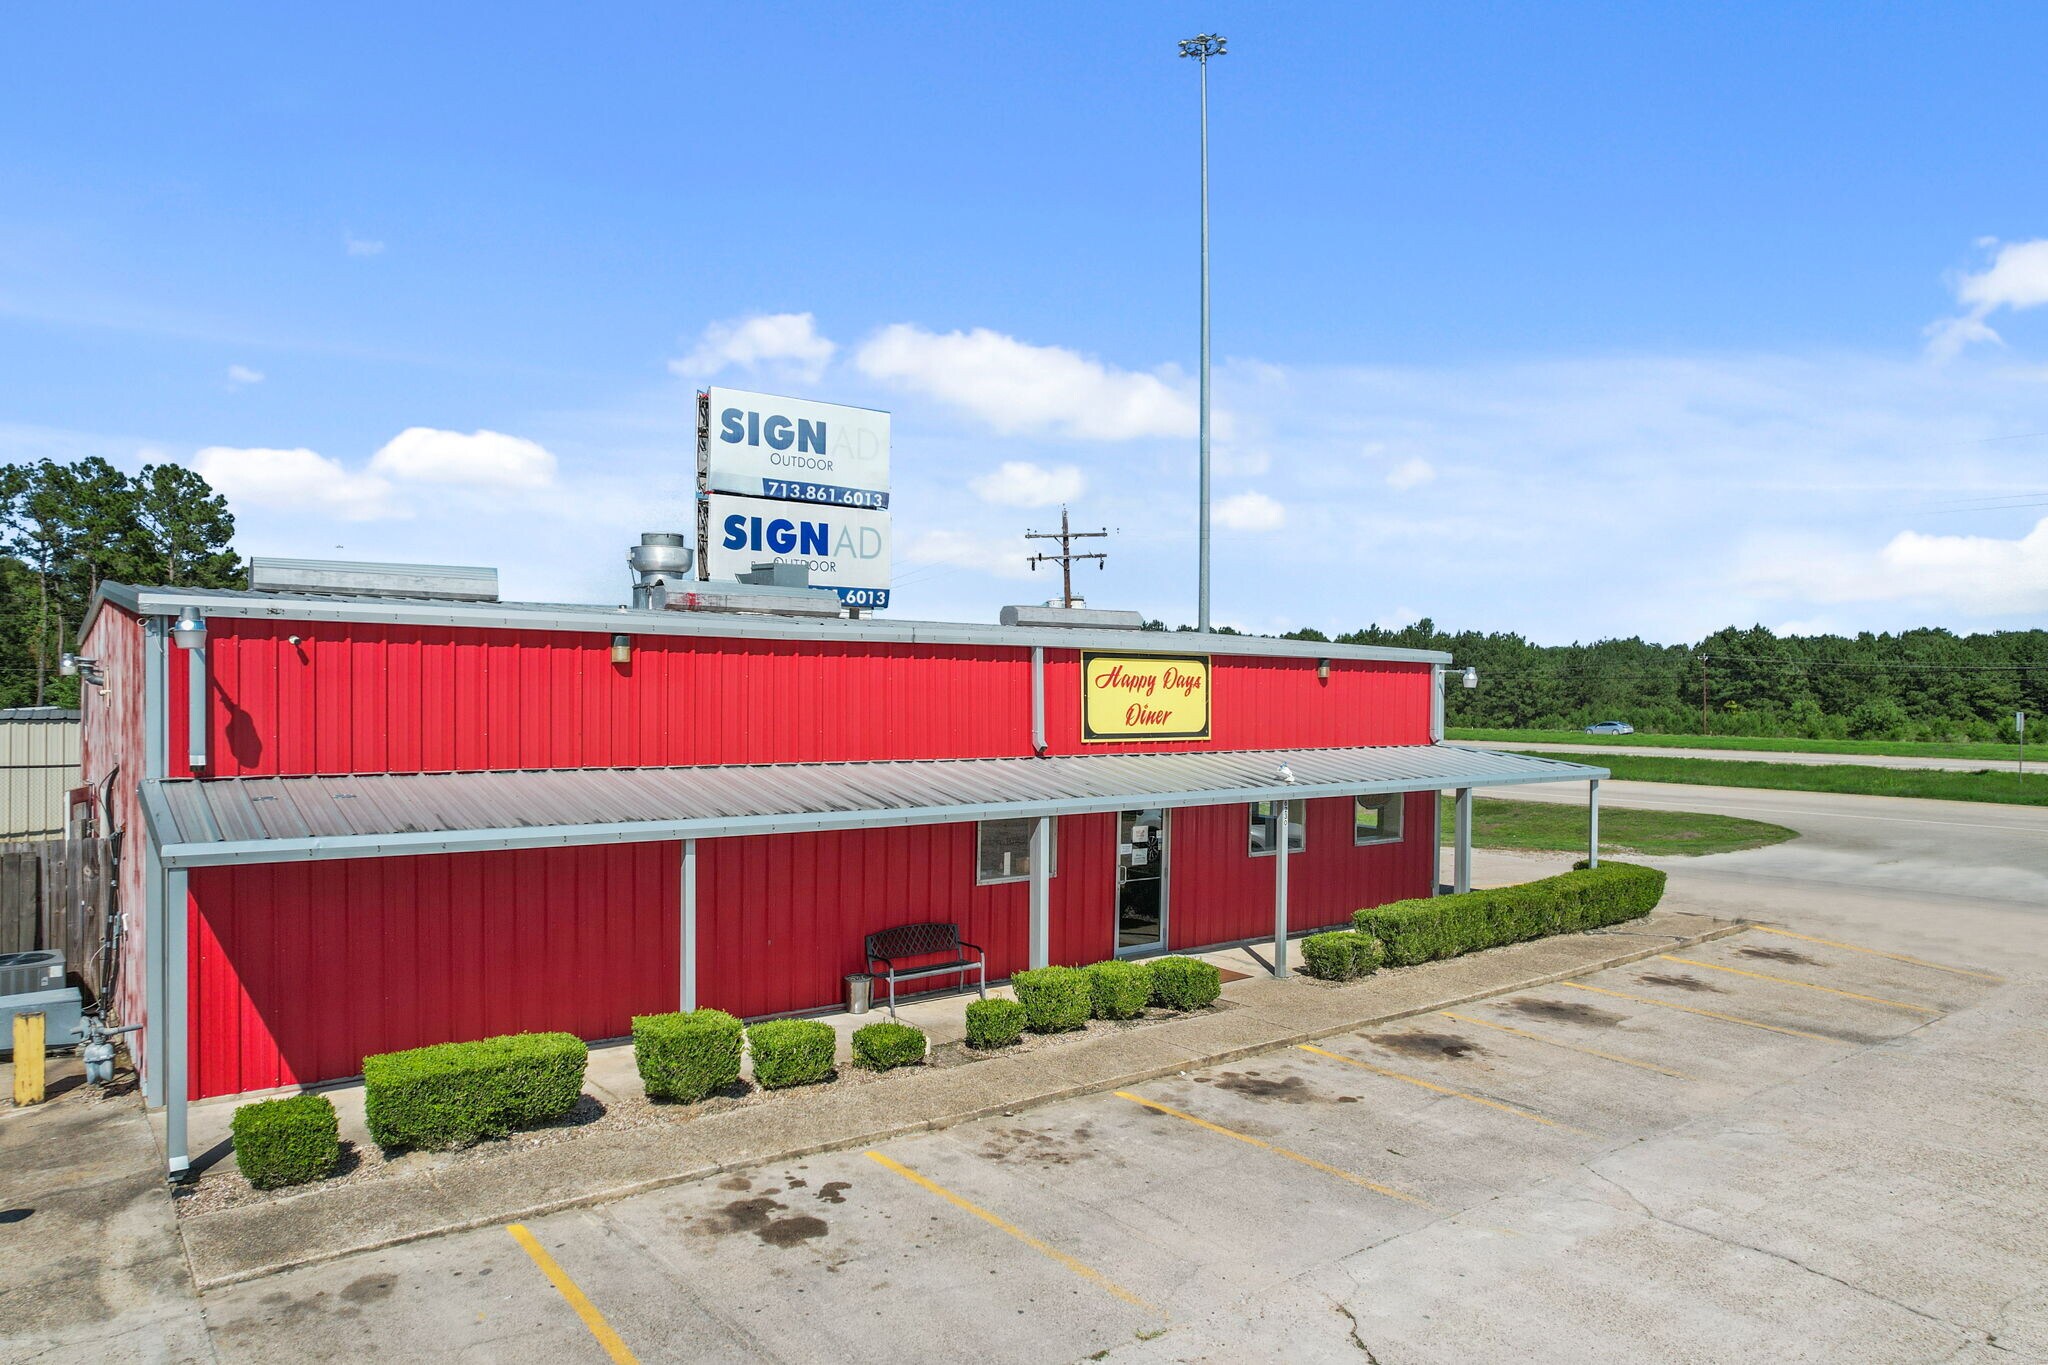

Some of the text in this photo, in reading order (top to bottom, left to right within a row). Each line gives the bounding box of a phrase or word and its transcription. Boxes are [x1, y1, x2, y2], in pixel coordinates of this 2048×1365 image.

[770, 452, 834, 472] OUTDOOR
[768, 481, 883, 507] 713.861.6013
[1095, 665, 1202, 697] Happy Days
[1125, 702, 1173, 727] Diner
